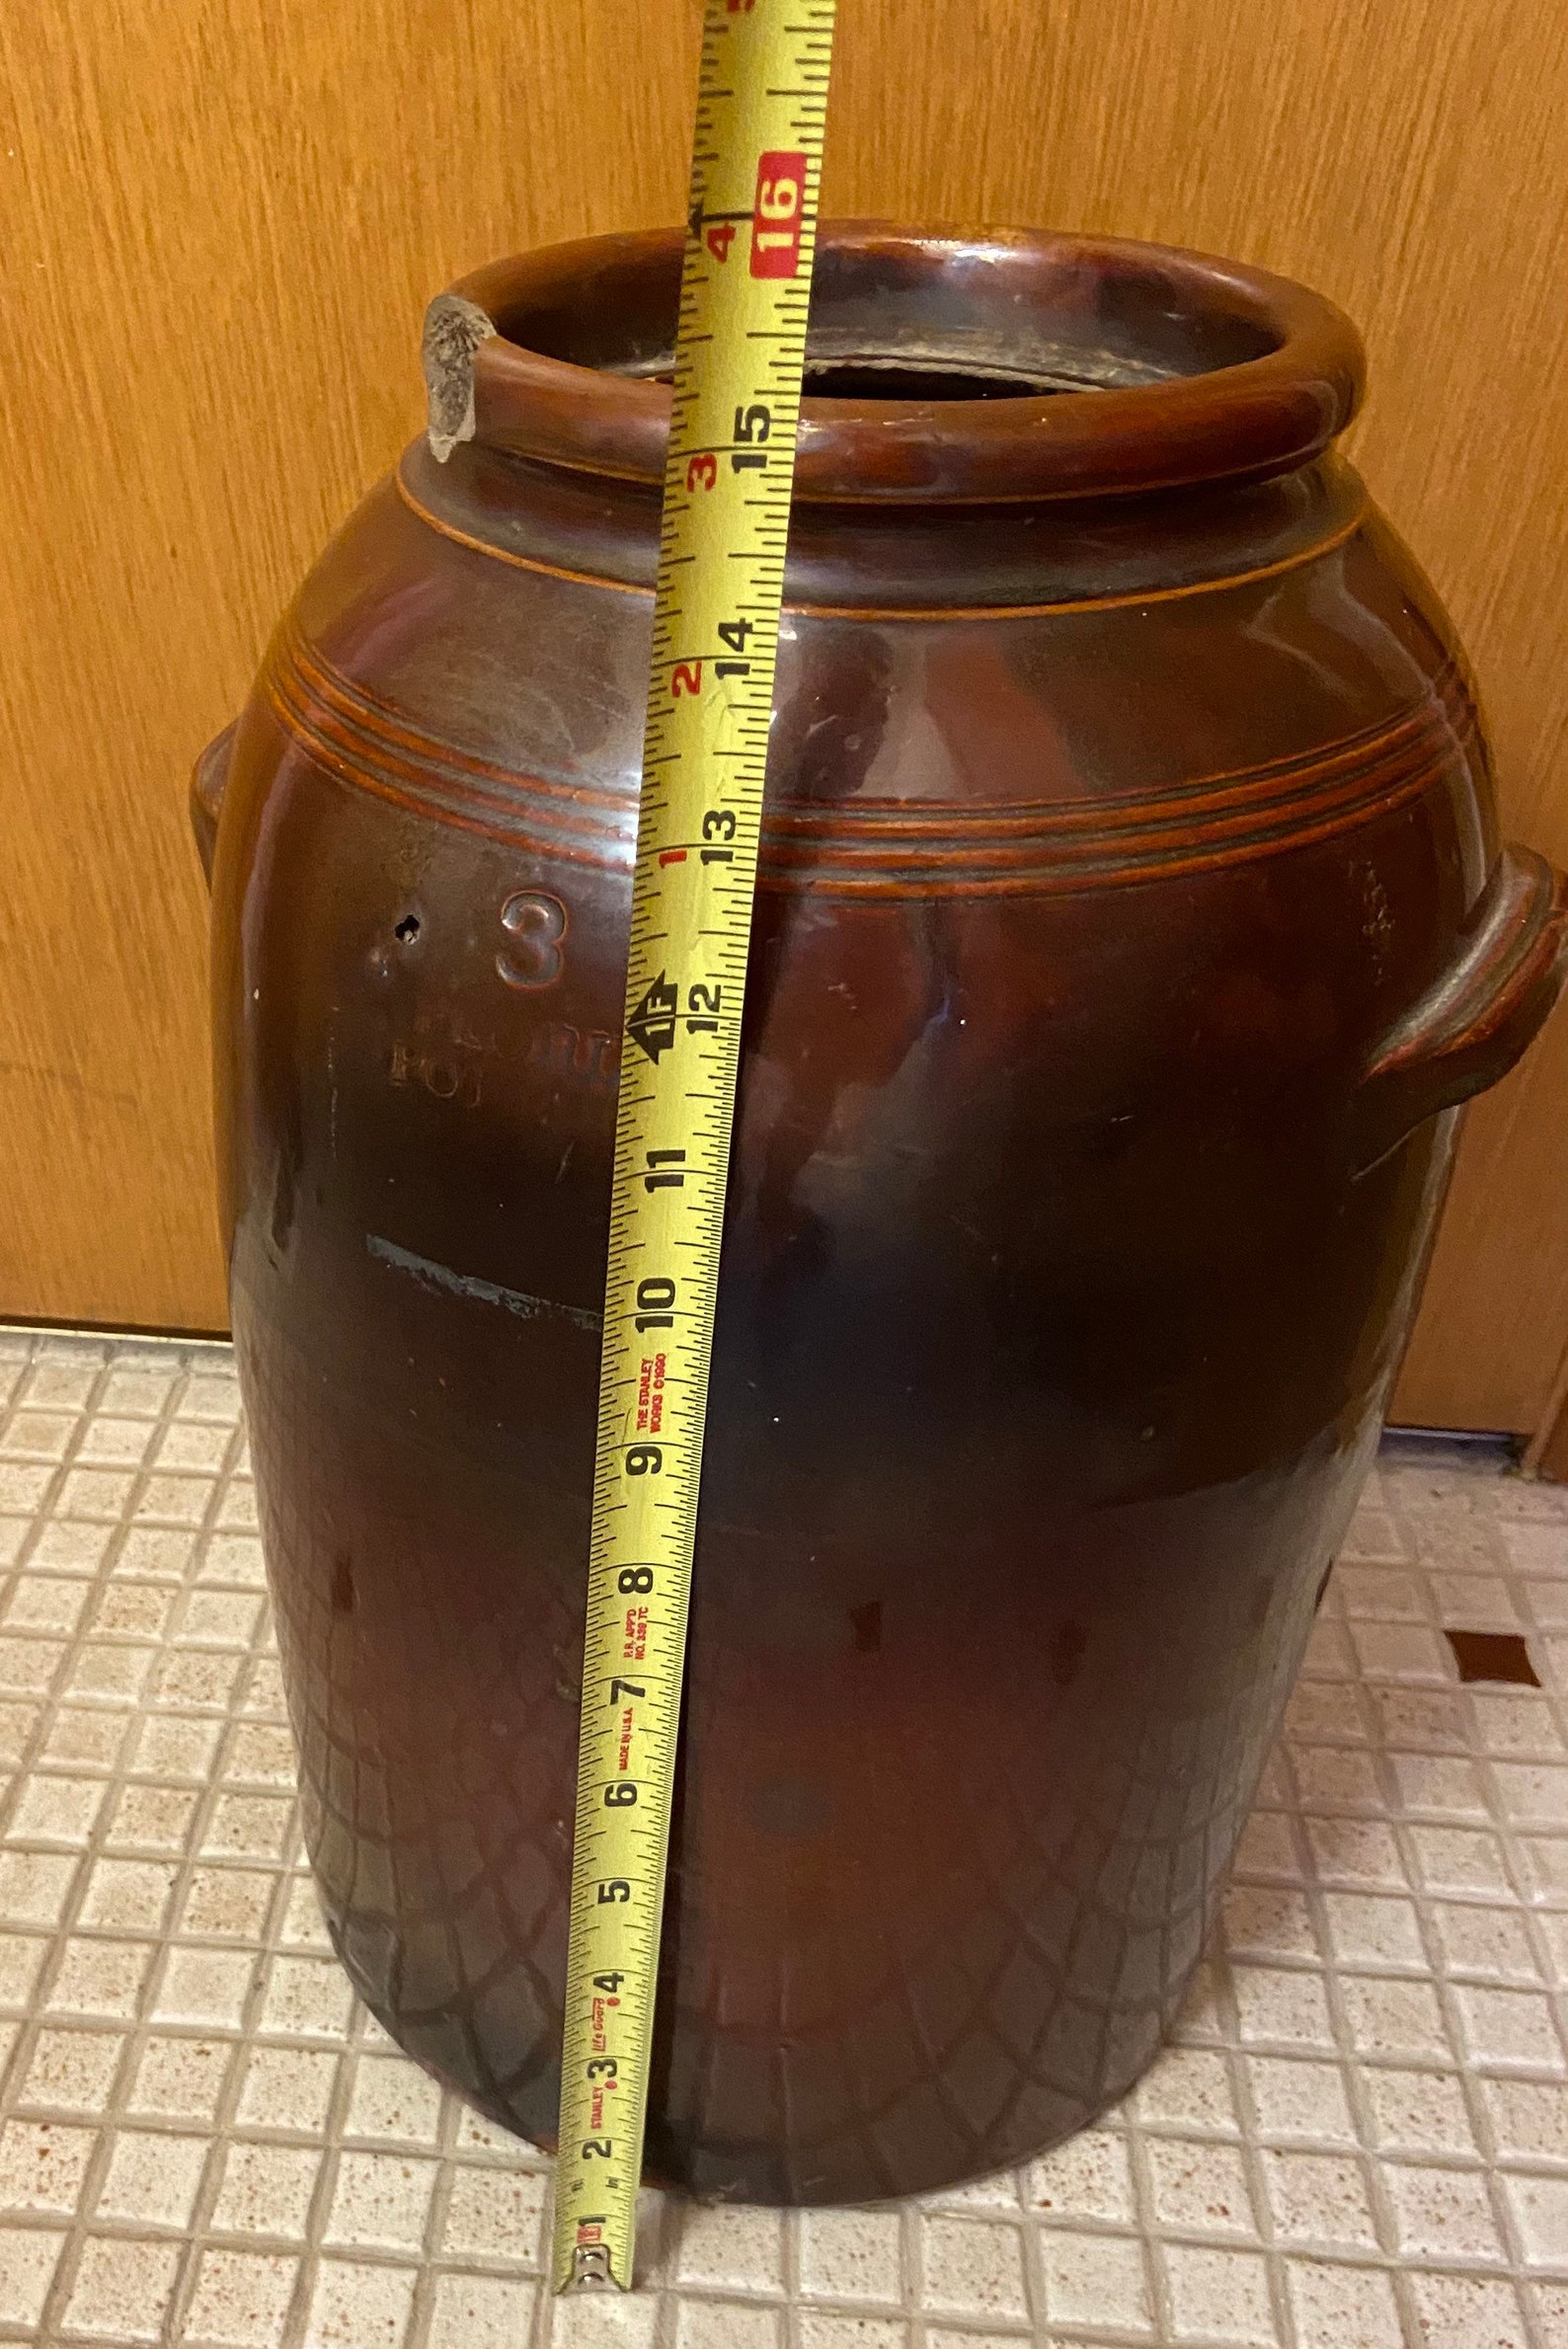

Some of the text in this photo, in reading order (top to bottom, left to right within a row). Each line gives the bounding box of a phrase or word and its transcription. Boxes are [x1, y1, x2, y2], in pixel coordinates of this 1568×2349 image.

[755, 178, 798, 253] 16
[706, 222, 737, 264] 4
[731, 405, 770, 473] 15
[686, 453, 718, 493] 3
[714, 617, 753, 680] 14
[671, 661, 702, 697] 2
[700, 810, 737, 866] 13
[658, 850, 687, 869] 1
[496, 889, 570, 991] 3
[686, 983, 722, 1035] 12
[644, 1149, 686, 1194] 11
[635, 1277, 676, 1334] 10
[636, 1358, 654, 1431] THE STANLEY
[649, 1394, 664, 1434] WORKS
[625, 1446, 663, 1476] 9
[618, 1567, 654, 1595] 8
[609, 1680, 646, 1705] 7
[618, 1745, 629, 1770] MADE
[620, 1734, 630, 1744] IN
[603, 1782, 638, 1807] 6
[597, 1881, 631, 1905] 5
[592, 1972, 625, 1994] 4
[587, 2059, 617, 2079] 3
[590, 2085, 603, 2130] STANLEY
[582, 2140, 612, 2160] 2
[578, 2216, 606, 2228] 1
